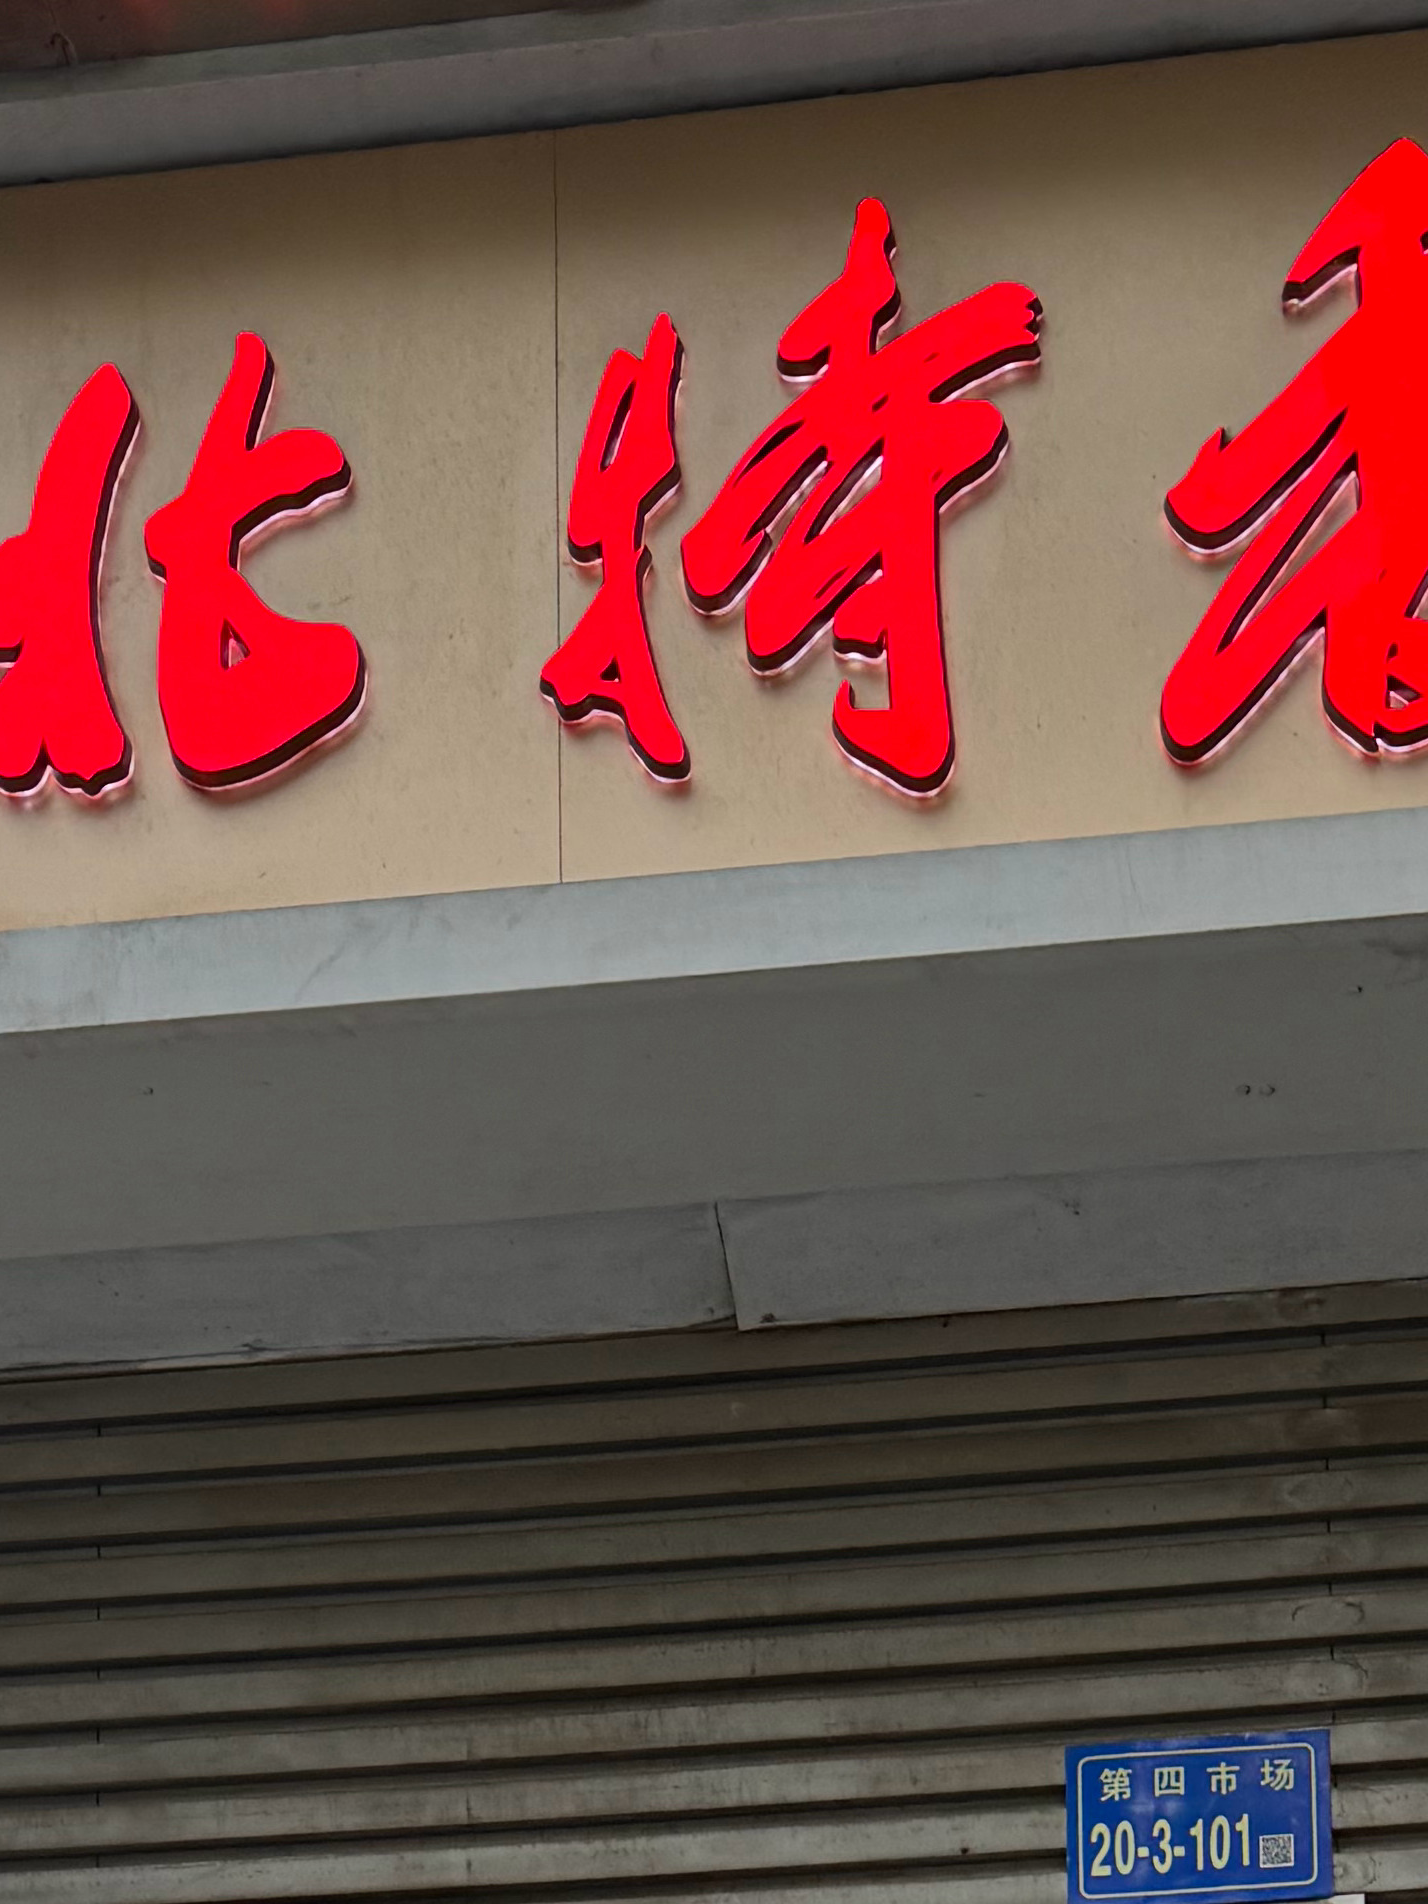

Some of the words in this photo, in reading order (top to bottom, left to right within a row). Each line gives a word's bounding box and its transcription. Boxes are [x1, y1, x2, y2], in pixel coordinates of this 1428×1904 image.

[1099, 1758, 1295, 1802] 第四市场
[1090, 1813, 1251, 1877] 20-3-101
